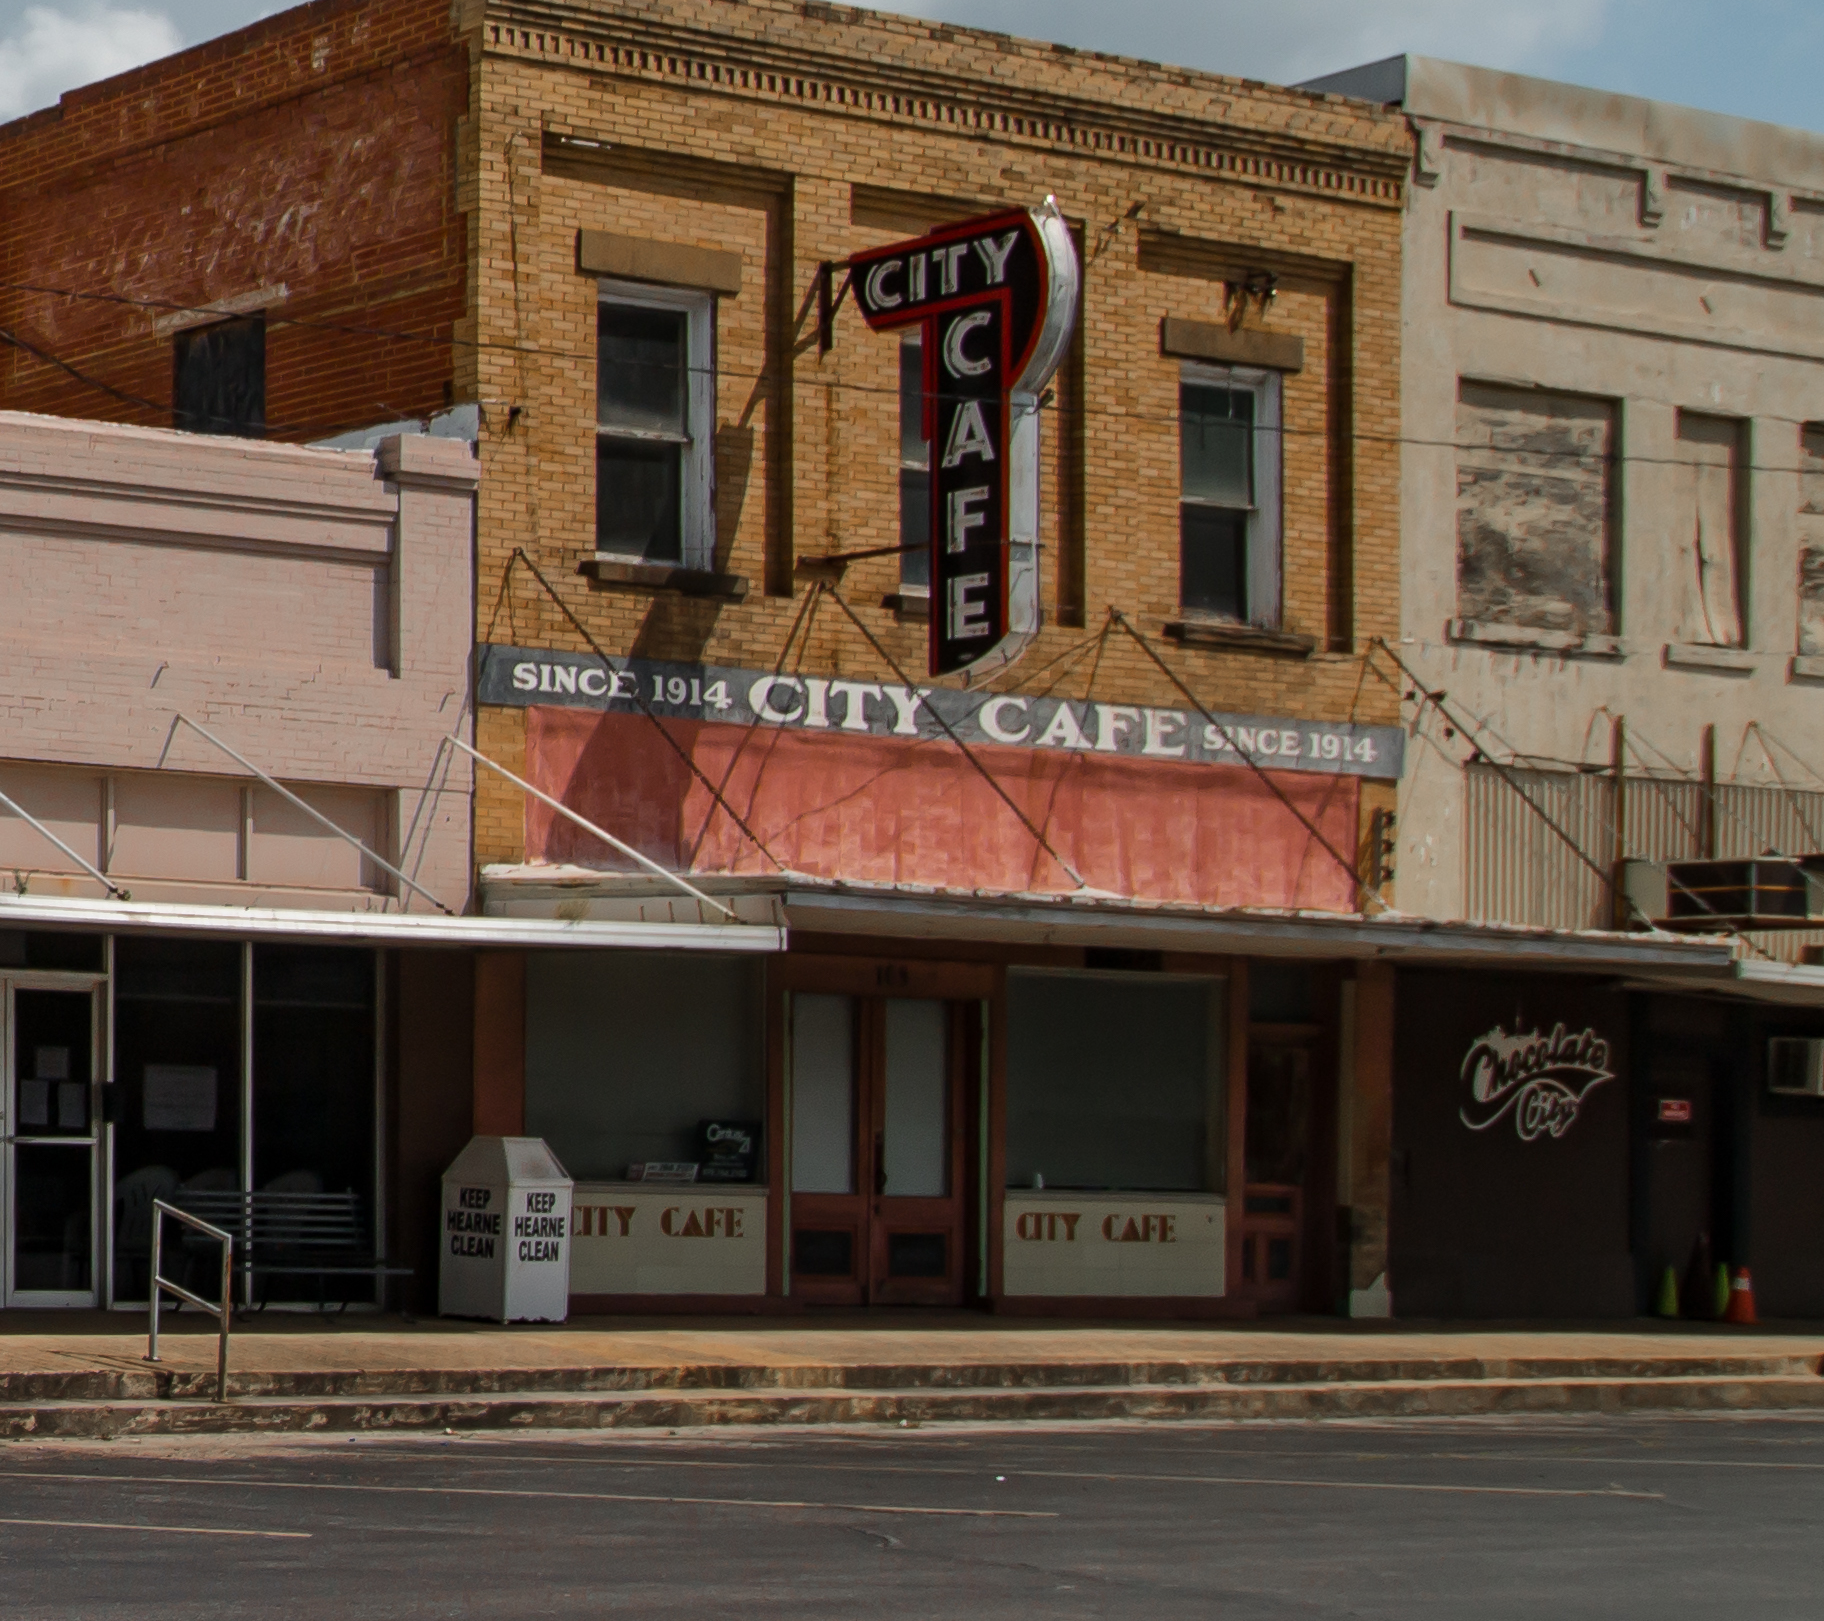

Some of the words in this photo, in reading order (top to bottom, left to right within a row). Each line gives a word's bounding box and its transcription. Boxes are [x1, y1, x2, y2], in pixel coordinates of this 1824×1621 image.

[865, 230, 1019, 310] CITY
[942, 311, 995, 641] CAFE
[512, 662, 639, 699] SINCE
[653, 675, 733, 710] 1914
[748, 676, 933, 735] CITY
[979, 696, 1188, 757] CAFE
[1202, 724, 1302, 758] SINCE
[1309, 732, 1379, 763] 1914
[1461, 1022, 1610, 1102] Chocolate
[1516, 1081, 1580, 1141] City
[459, 1187, 491, 1209] KEEP
[526, 1192, 556, 1213] KEEP
[446, 1210, 501, 1235] HEARNE
[514, 1216, 565, 1238] HEARNE
[660, 1206, 744, 1238] CAFE
[1016, 1212, 1082, 1241] CITY
[1102, 1213, 1177, 1243] CAFE
[451, 1234, 494, 1258] CLEAN
[518, 1240, 559, 1262] CLEAN
